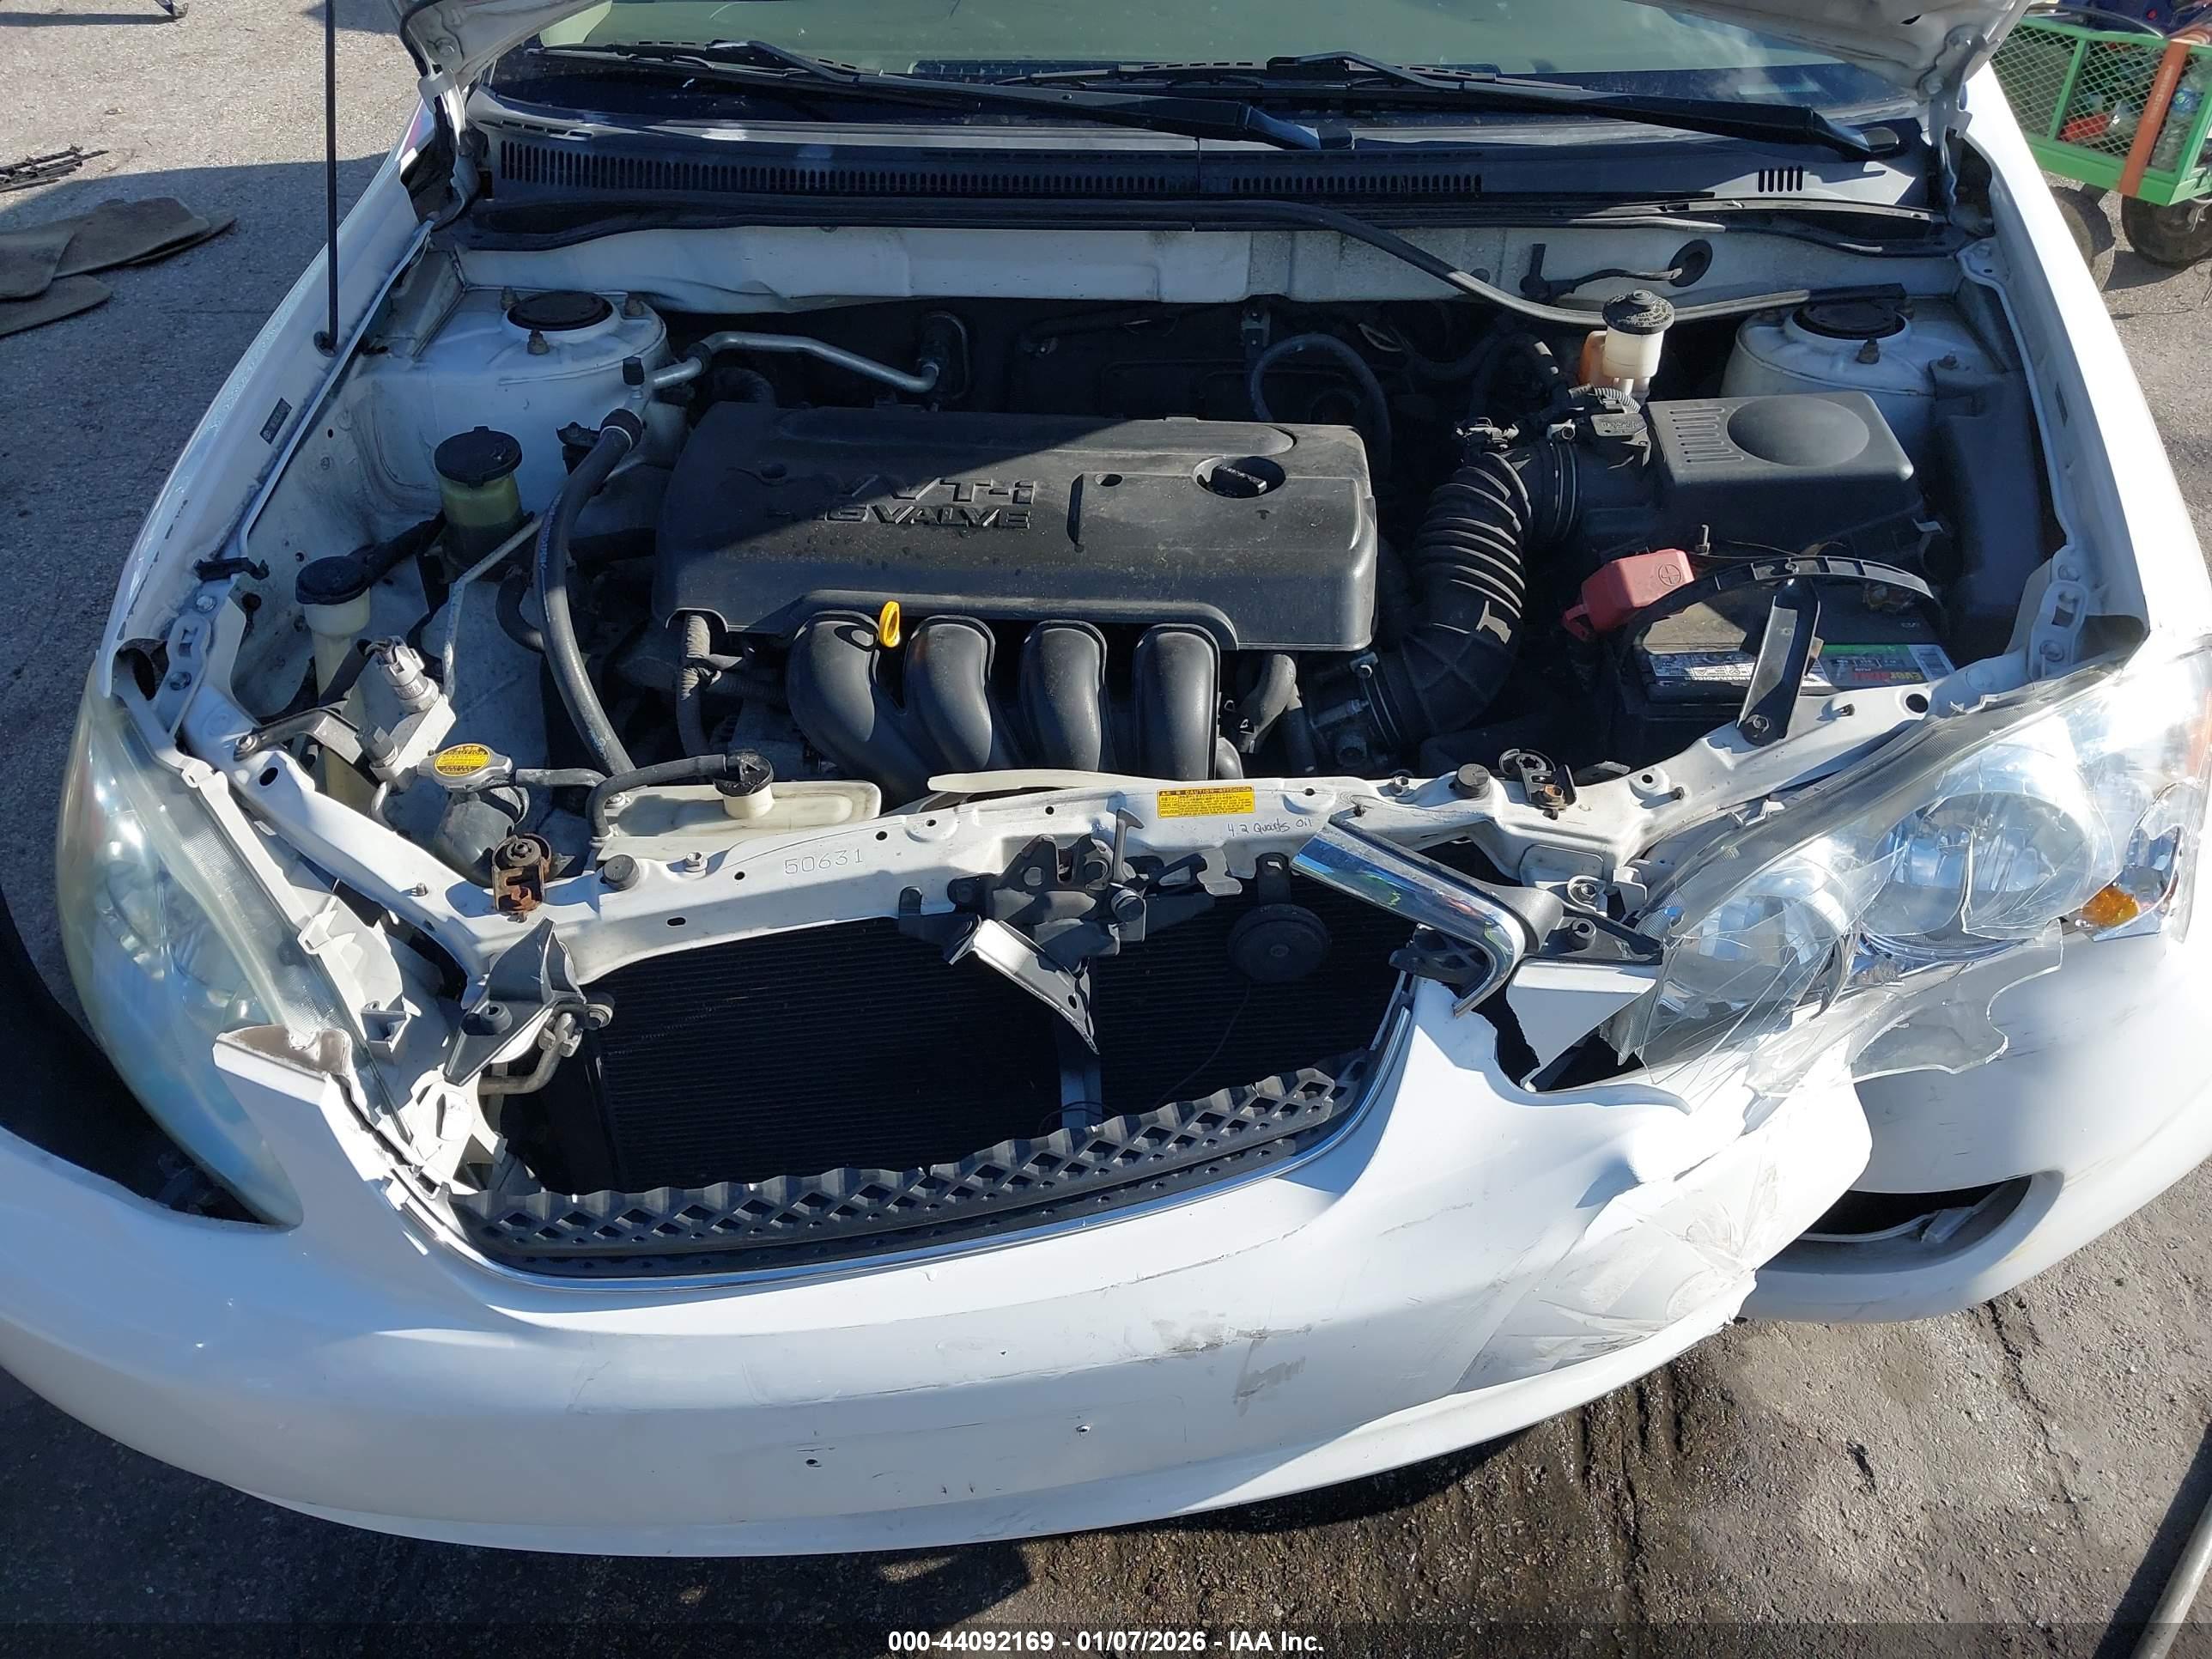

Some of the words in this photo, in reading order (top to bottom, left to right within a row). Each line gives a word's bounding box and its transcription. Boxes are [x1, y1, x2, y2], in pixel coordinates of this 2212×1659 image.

[1254, 817, 1291, 835] Quarts
[1296, 817, 1312, 828] Oil
[785, 848, 863, 874] 50631
